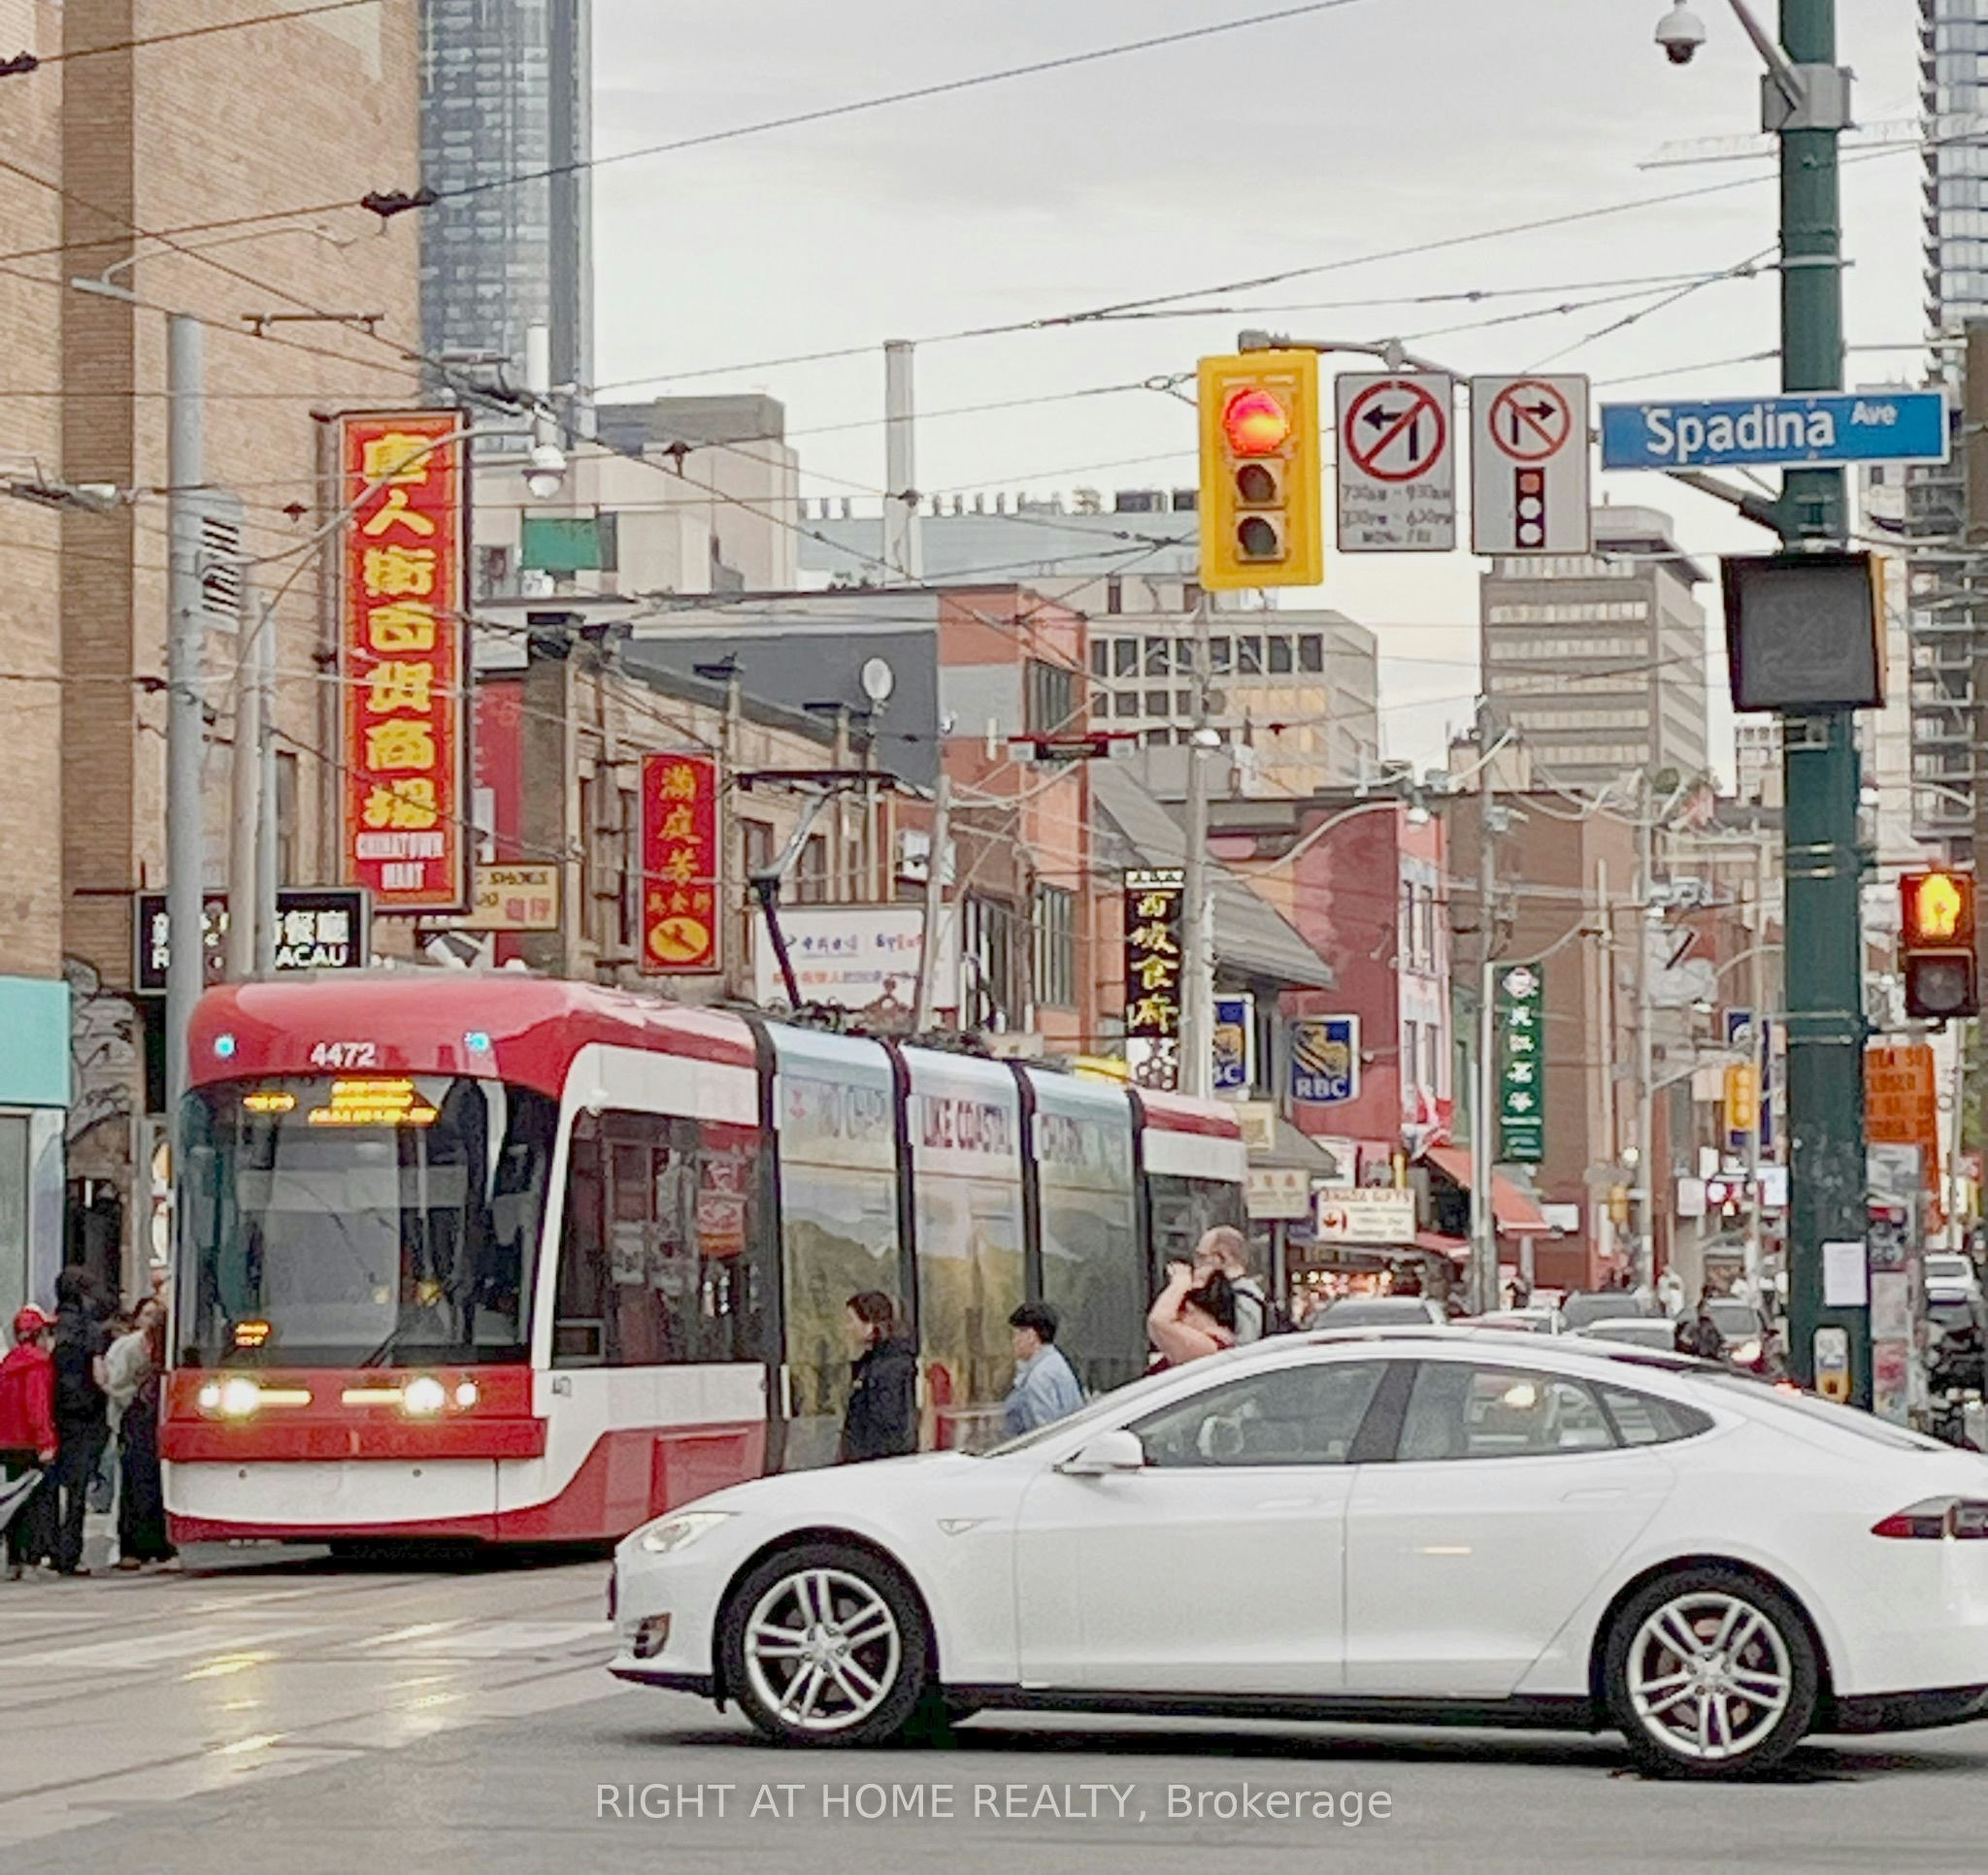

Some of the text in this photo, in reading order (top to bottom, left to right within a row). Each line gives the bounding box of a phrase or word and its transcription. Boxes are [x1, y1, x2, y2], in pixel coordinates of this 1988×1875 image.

[1645, 401, 1898, 464] Spadina Ave
[276, 944, 348, 967] ACAU
[311, 1041, 378, 1068] 4472
[1296, 1076, 1347, 1098] RBC
